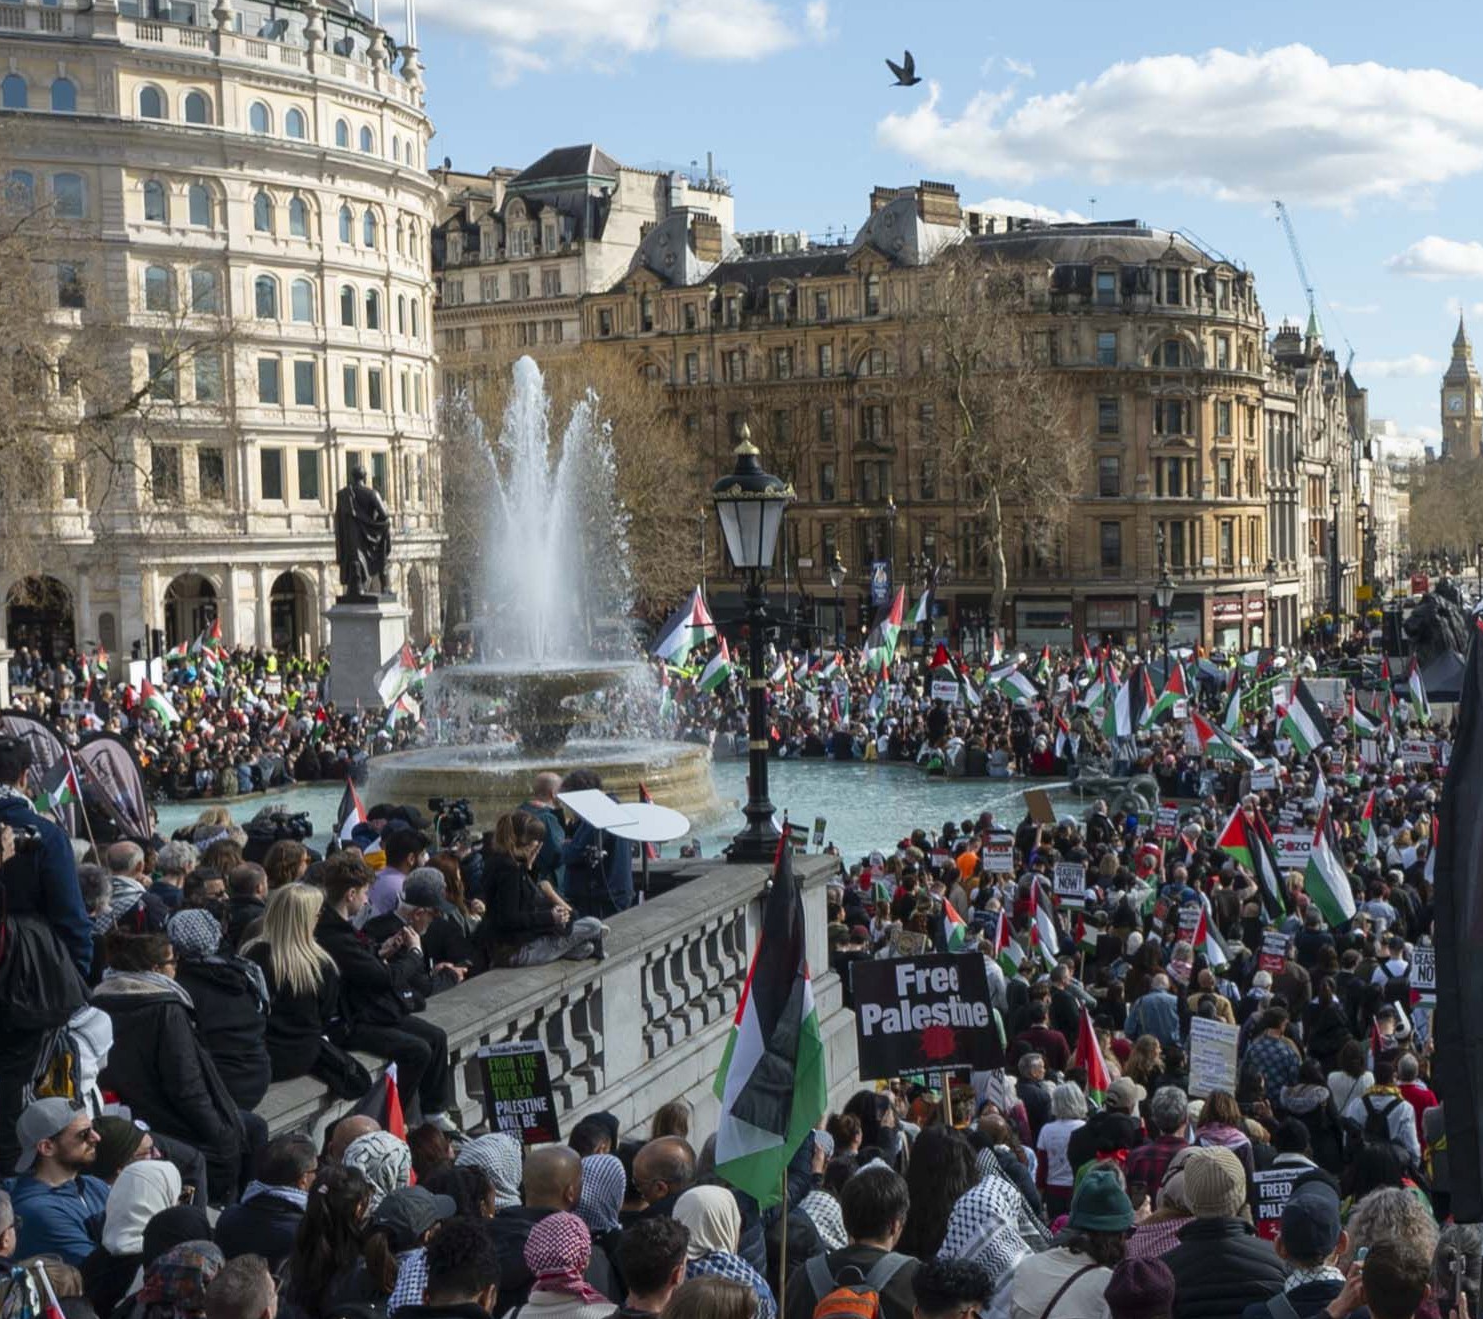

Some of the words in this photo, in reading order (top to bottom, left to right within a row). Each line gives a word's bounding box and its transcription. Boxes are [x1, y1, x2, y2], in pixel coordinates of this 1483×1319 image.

[1276, 839, 1311, 852] Gza
[895, 962, 959, 996] Free
[861, 995, 988, 1036] Palestine
[495, 1097, 548, 1116] PALESTINE
[497, 1115, 521, 1130] WILL
[523, 1113, 537, 1128] BE
[1259, 1182, 1292, 1198] FREED
